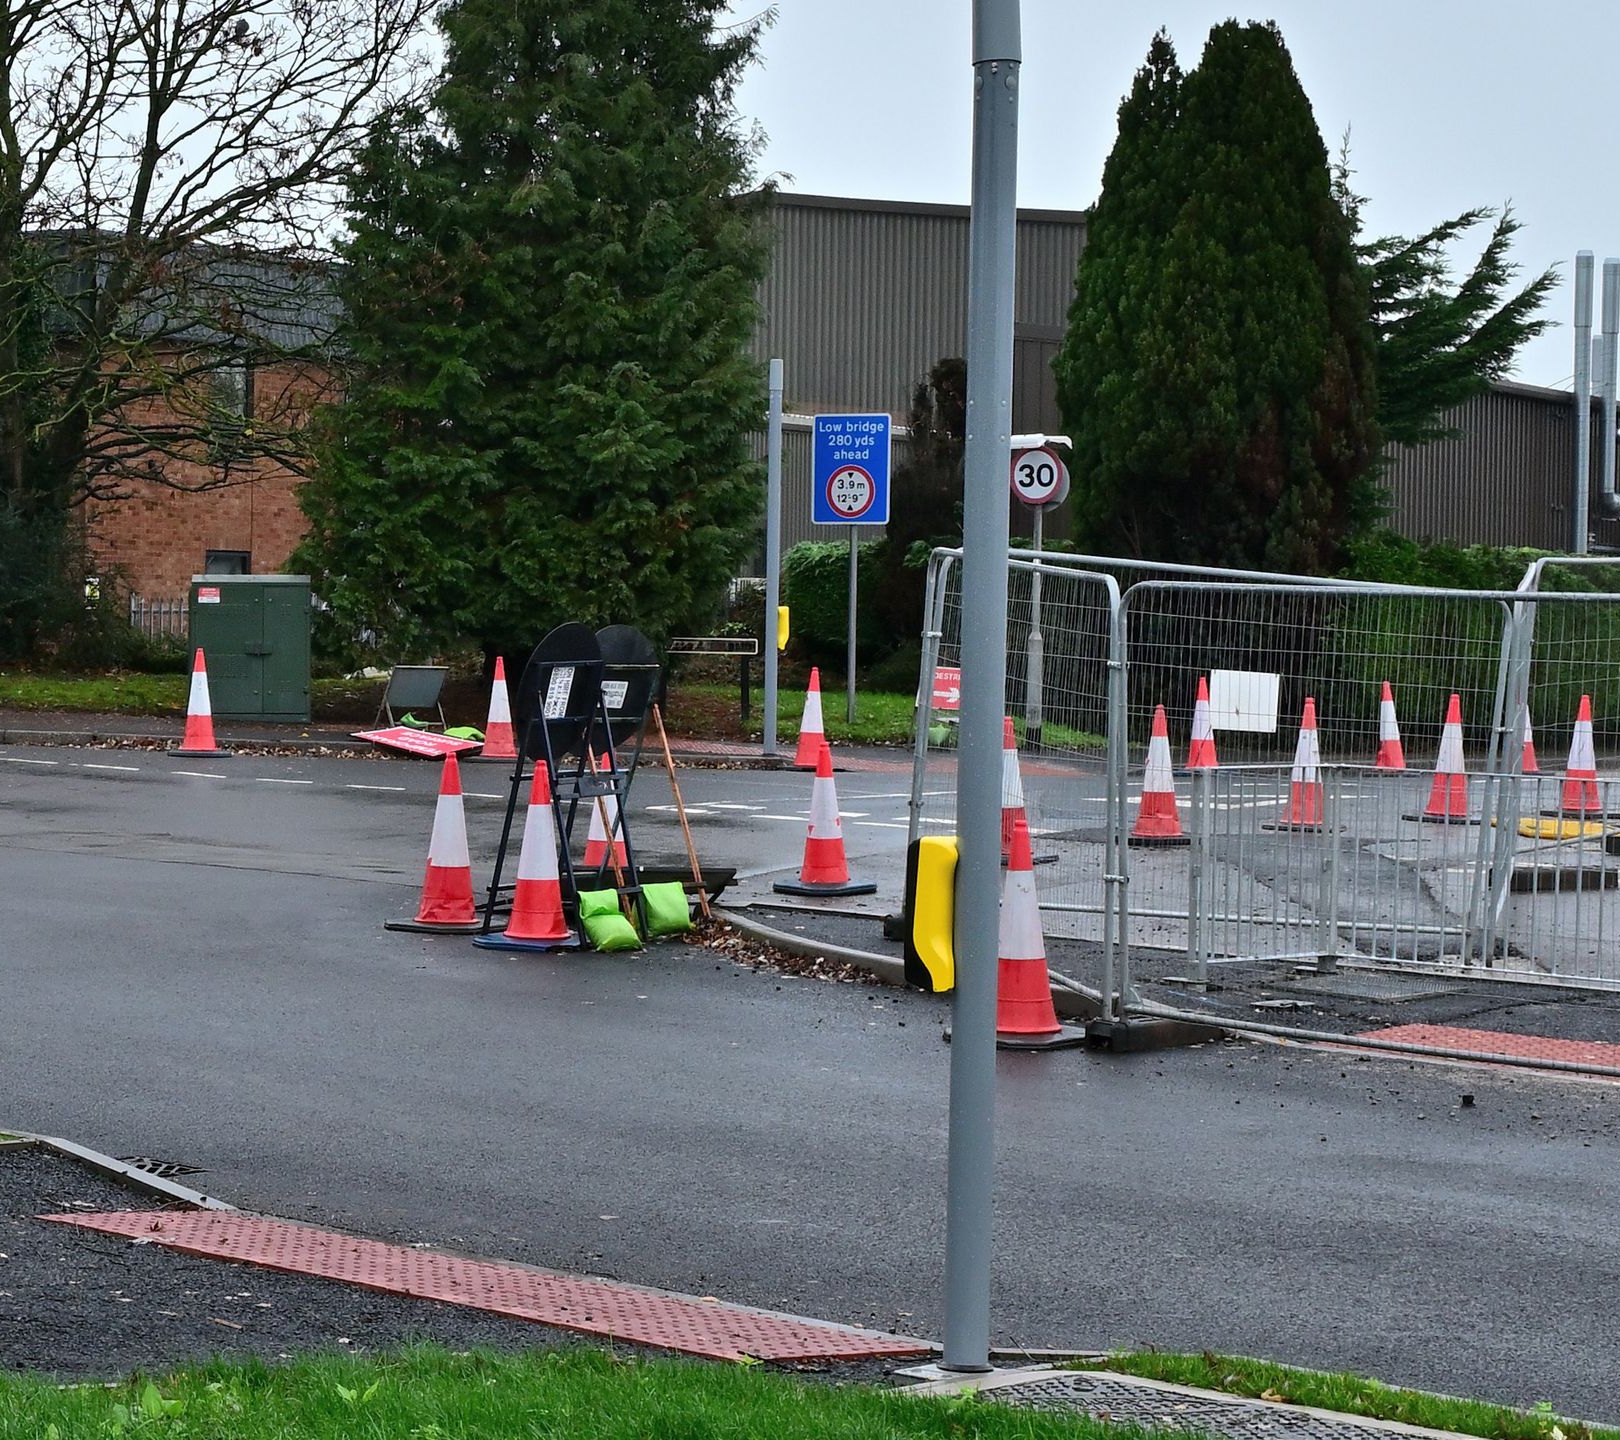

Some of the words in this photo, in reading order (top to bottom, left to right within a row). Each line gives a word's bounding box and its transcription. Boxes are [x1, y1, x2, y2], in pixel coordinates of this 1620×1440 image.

[819, 421, 842, 432] Low
[846, 421, 884, 434] bridge
[828, 435, 852, 446] 280
[855, 435, 875, 448] yds
[833, 449, 869, 460] ahead
[1018, 463, 1054, 488] 30
